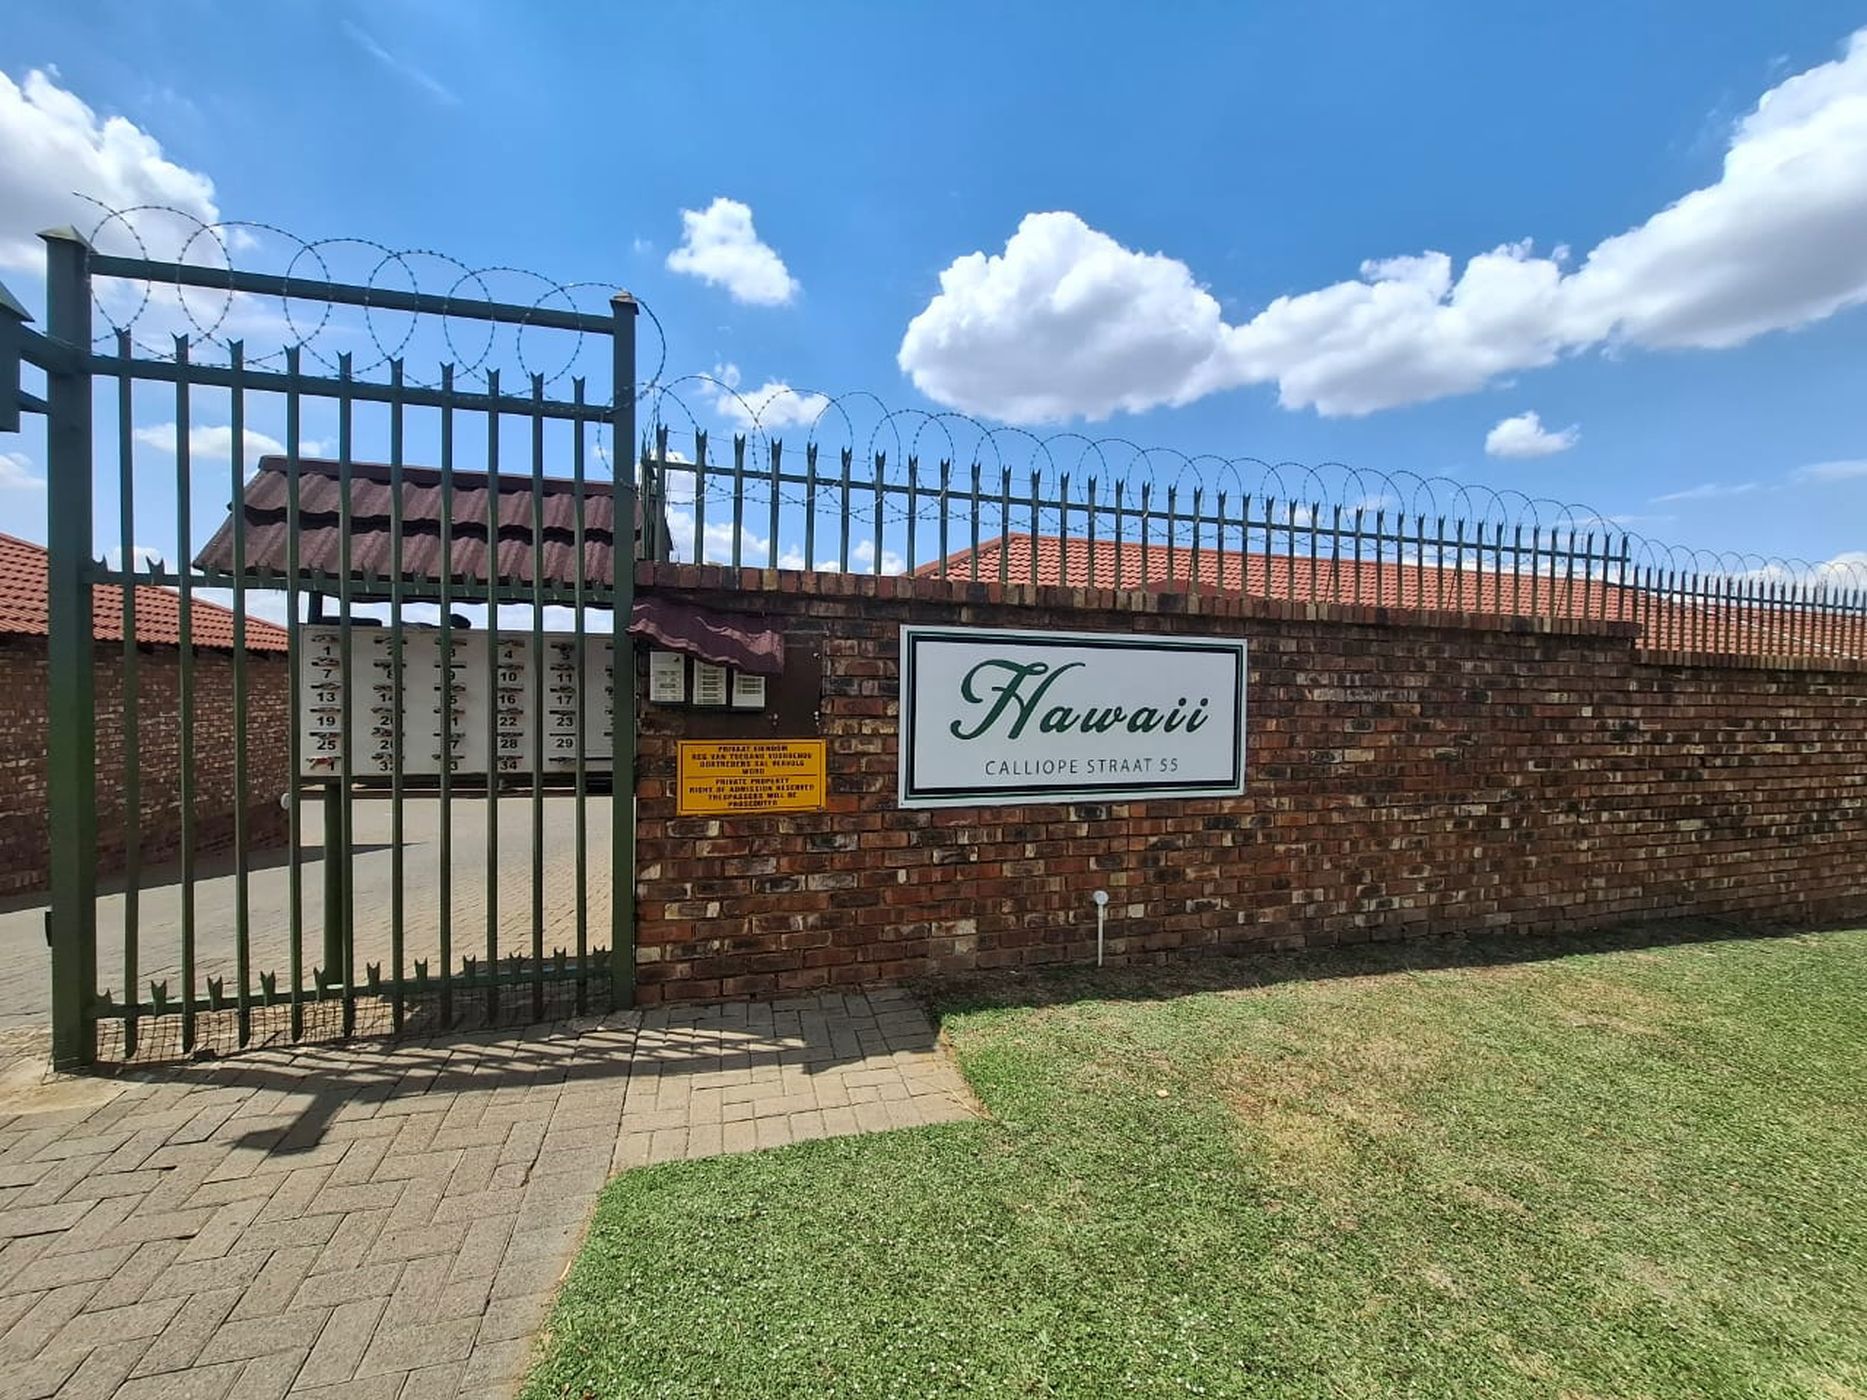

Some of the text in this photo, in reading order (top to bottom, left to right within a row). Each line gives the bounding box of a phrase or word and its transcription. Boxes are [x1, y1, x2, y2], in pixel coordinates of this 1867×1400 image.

[324, 646, 332, 656] 1
[504, 650, 513, 659] 4
[561, 652, 570, 660] 5
[322, 668, 332, 679] 7
[500, 671, 517, 682] 10
[557, 673, 572, 682] 11
[317, 692, 336, 702] 13
[498, 694, 516, 704] 16
[556, 695, 572, 705] 17
[950, 658, 1209, 740] Hawaii
[317, 716, 336, 726] 19
[499, 716, 517, 727] 22
[556, 717, 573, 727] 23
[317, 740, 336, 750] 25
[500, 739, 518, 749] 28
[556, 739, 573, 748] 29
[500, 760, 517, 770] 34
[985, 757, 1179, 776] CALLIOPE STRAAT 55
[751, 777, 789, 785] PROPERTY
